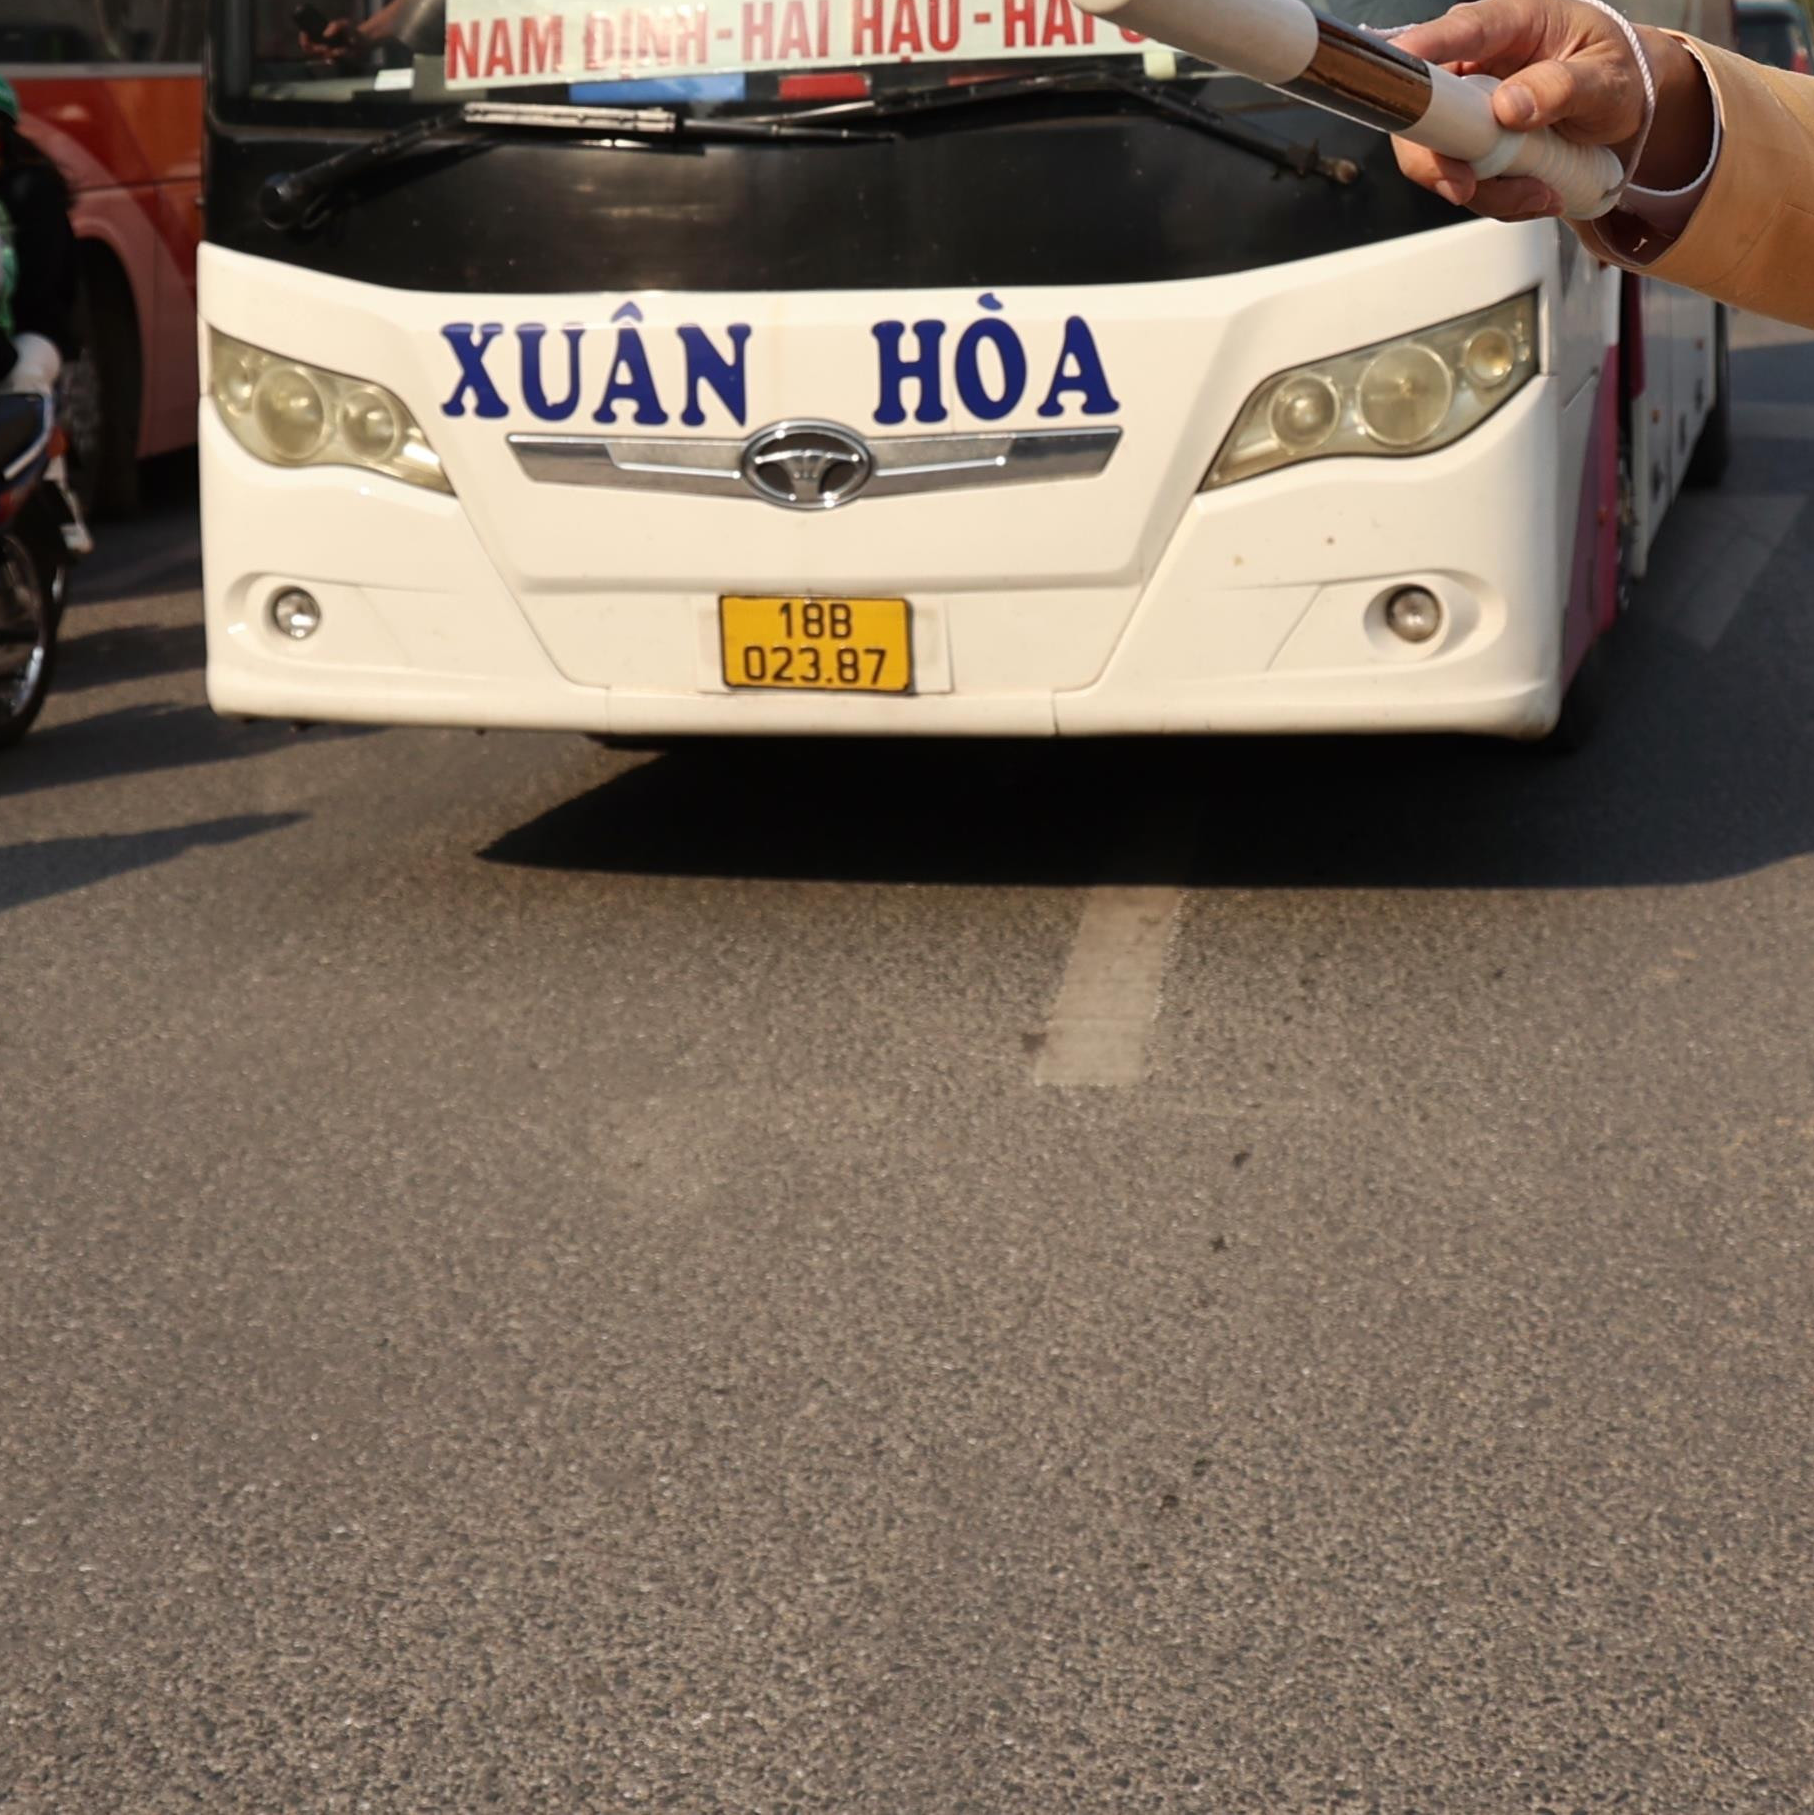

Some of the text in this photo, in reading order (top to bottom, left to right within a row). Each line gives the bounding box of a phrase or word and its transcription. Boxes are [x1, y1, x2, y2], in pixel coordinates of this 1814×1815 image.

[446, 15, 564, 80] NAM
[440, 292, 1120, 428] XUÂN HÒA
[779, 602, 852, 639] 18B
[744, 646, 887, 684] 023.87
